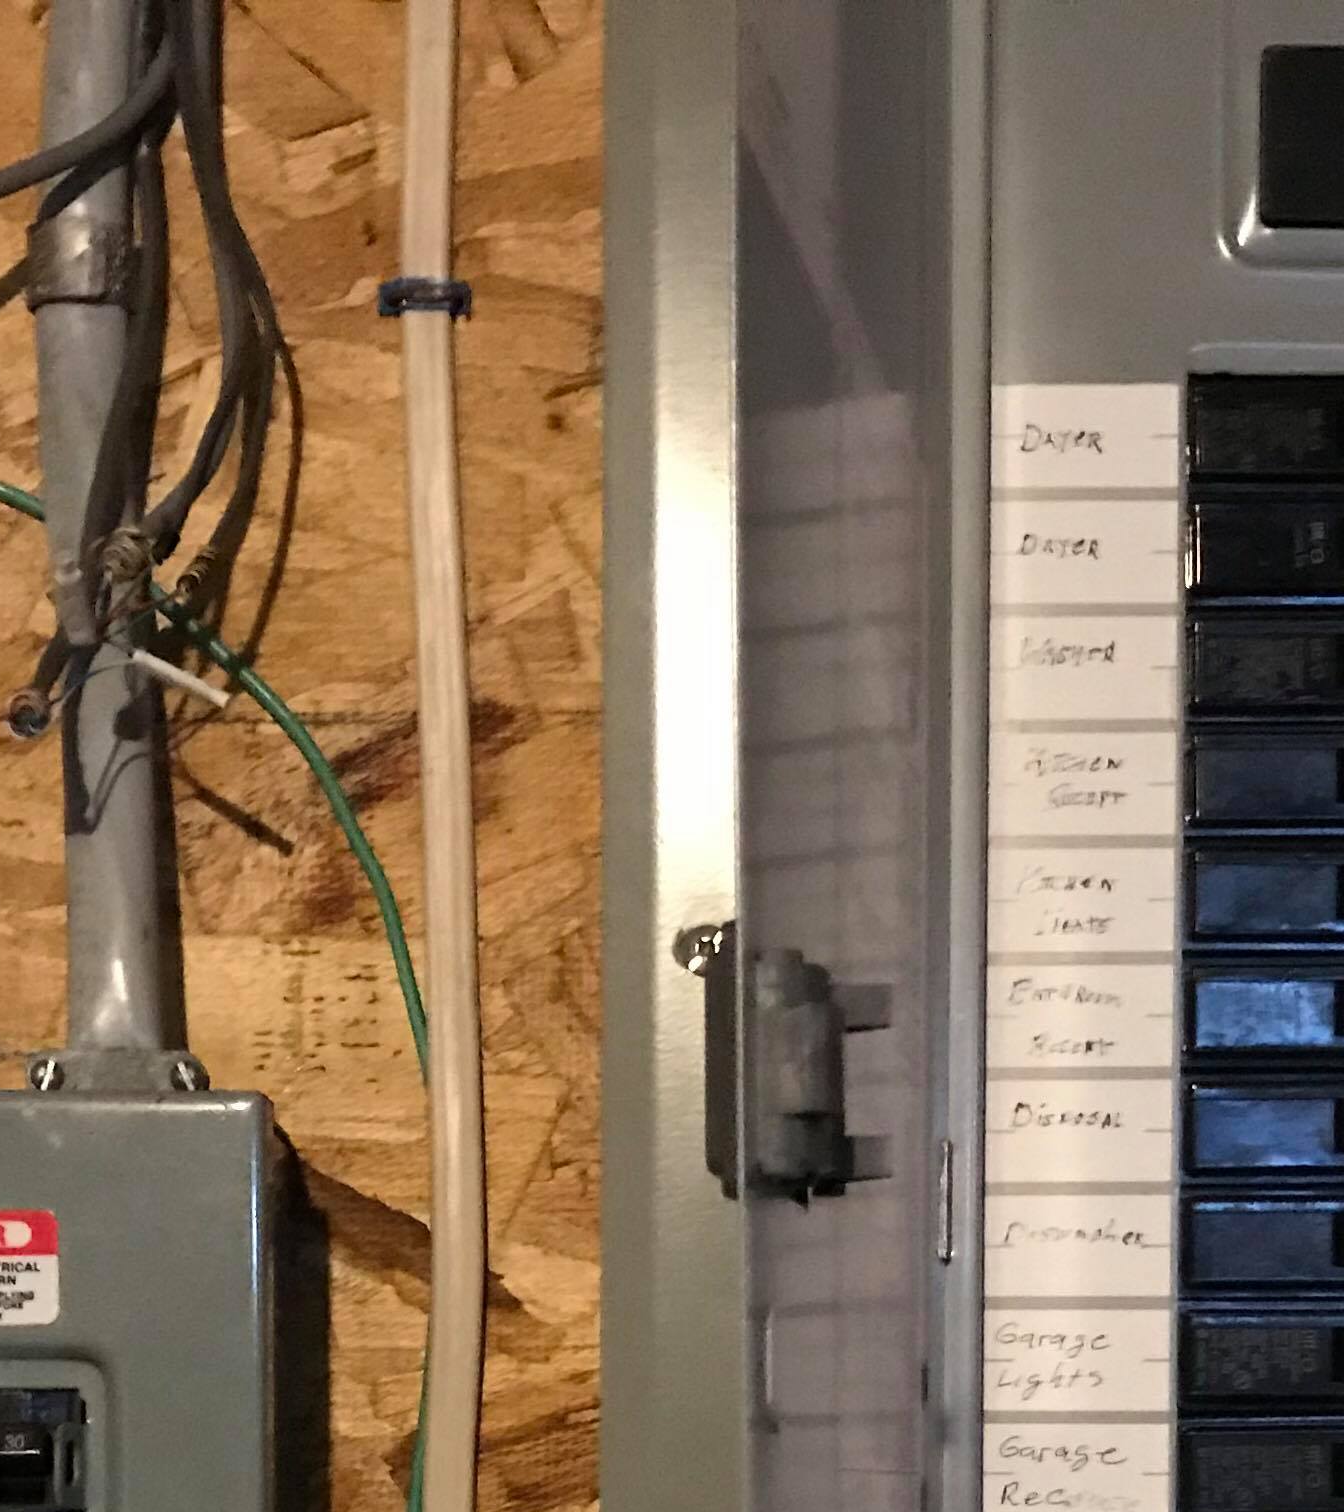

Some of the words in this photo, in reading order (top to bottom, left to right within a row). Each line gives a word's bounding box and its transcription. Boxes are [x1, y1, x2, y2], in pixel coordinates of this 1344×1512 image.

[995, 1322, 1111, 1359] Garage
[5, 1433, 26, 1449] 30
[999, 1435, 1127, 1472] Garage
